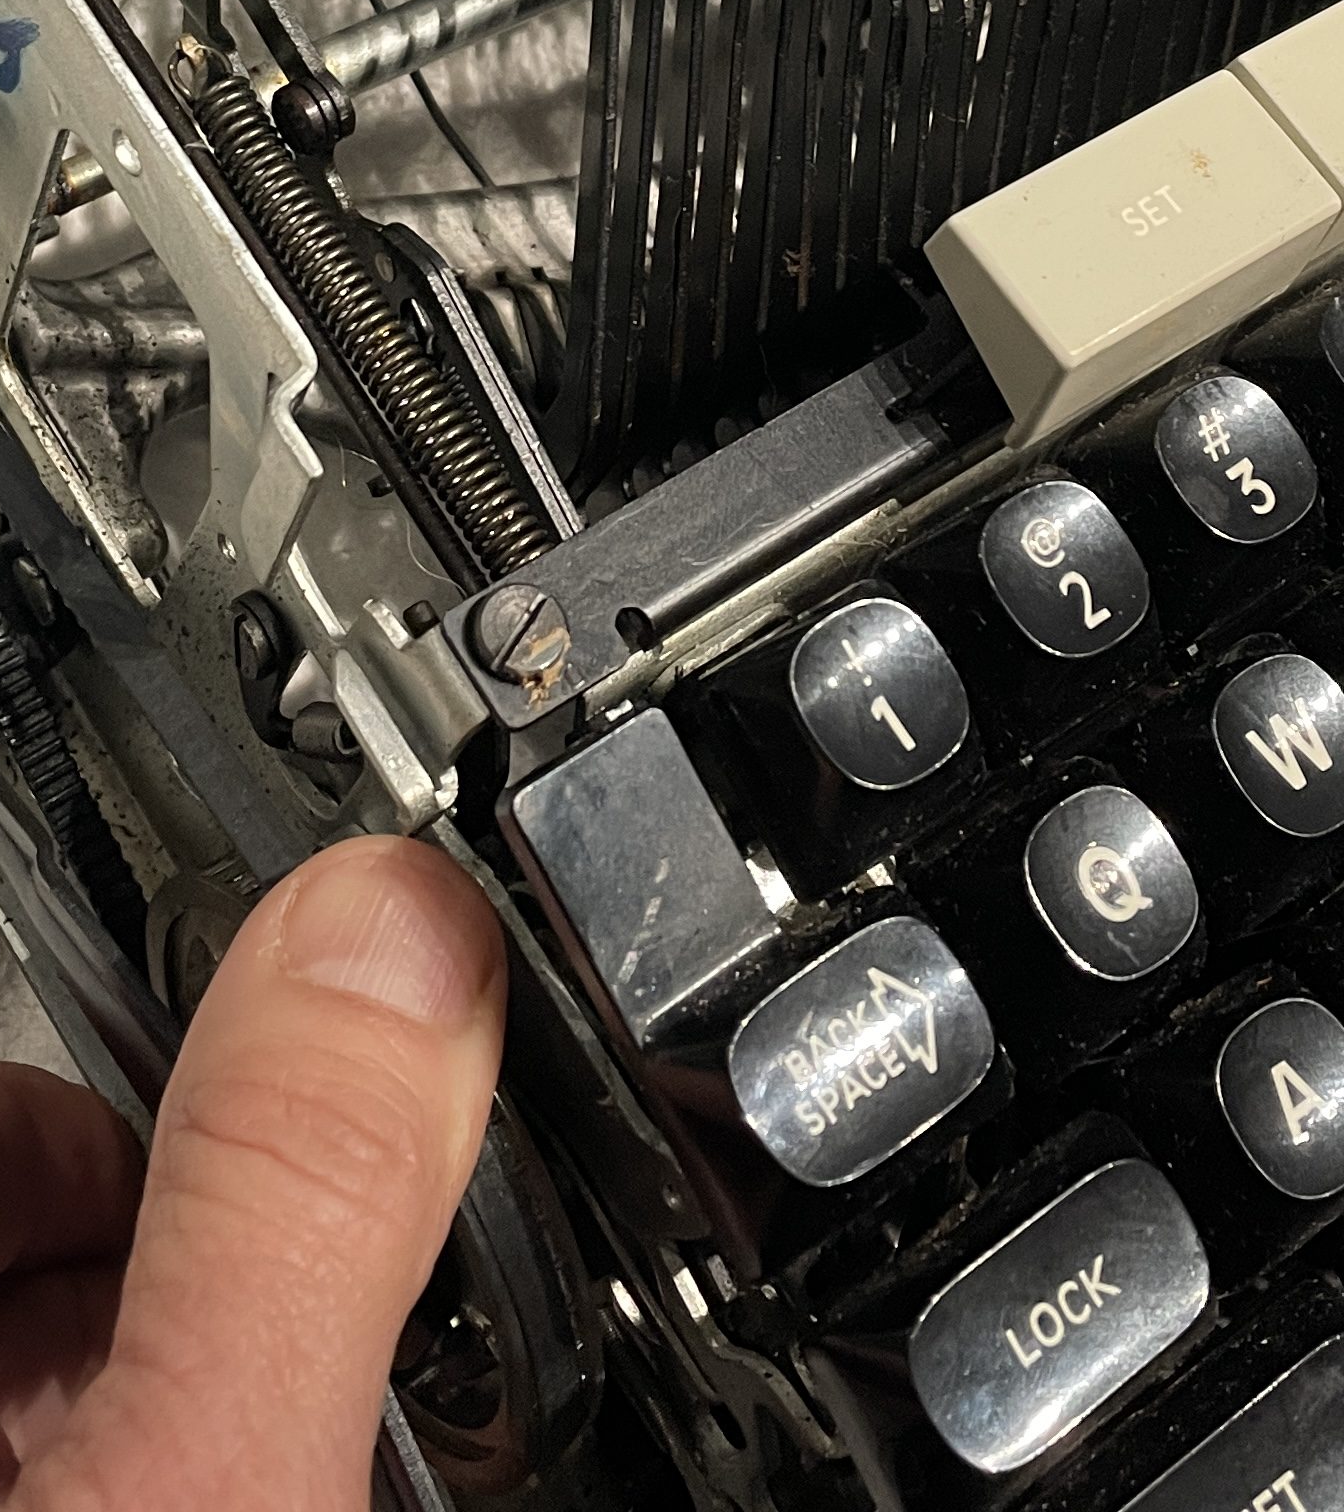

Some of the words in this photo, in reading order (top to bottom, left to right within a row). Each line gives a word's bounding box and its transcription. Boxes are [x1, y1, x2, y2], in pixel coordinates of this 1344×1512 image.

[1120, 181, 1183, 238] SET
[1224, 456, 1276, 515] 3
[1058, 570, 1112, 630] 2
[869, 694, 918, 753] 1
[1244, 696, 1335, 791] W
[1074, 845, 1154, 923] Q
[794, 1036, 906, 1137] SPACE
[1270, 1059, 1326, 1146] A
[1004, 1253, 1122, 1370] LOCK
